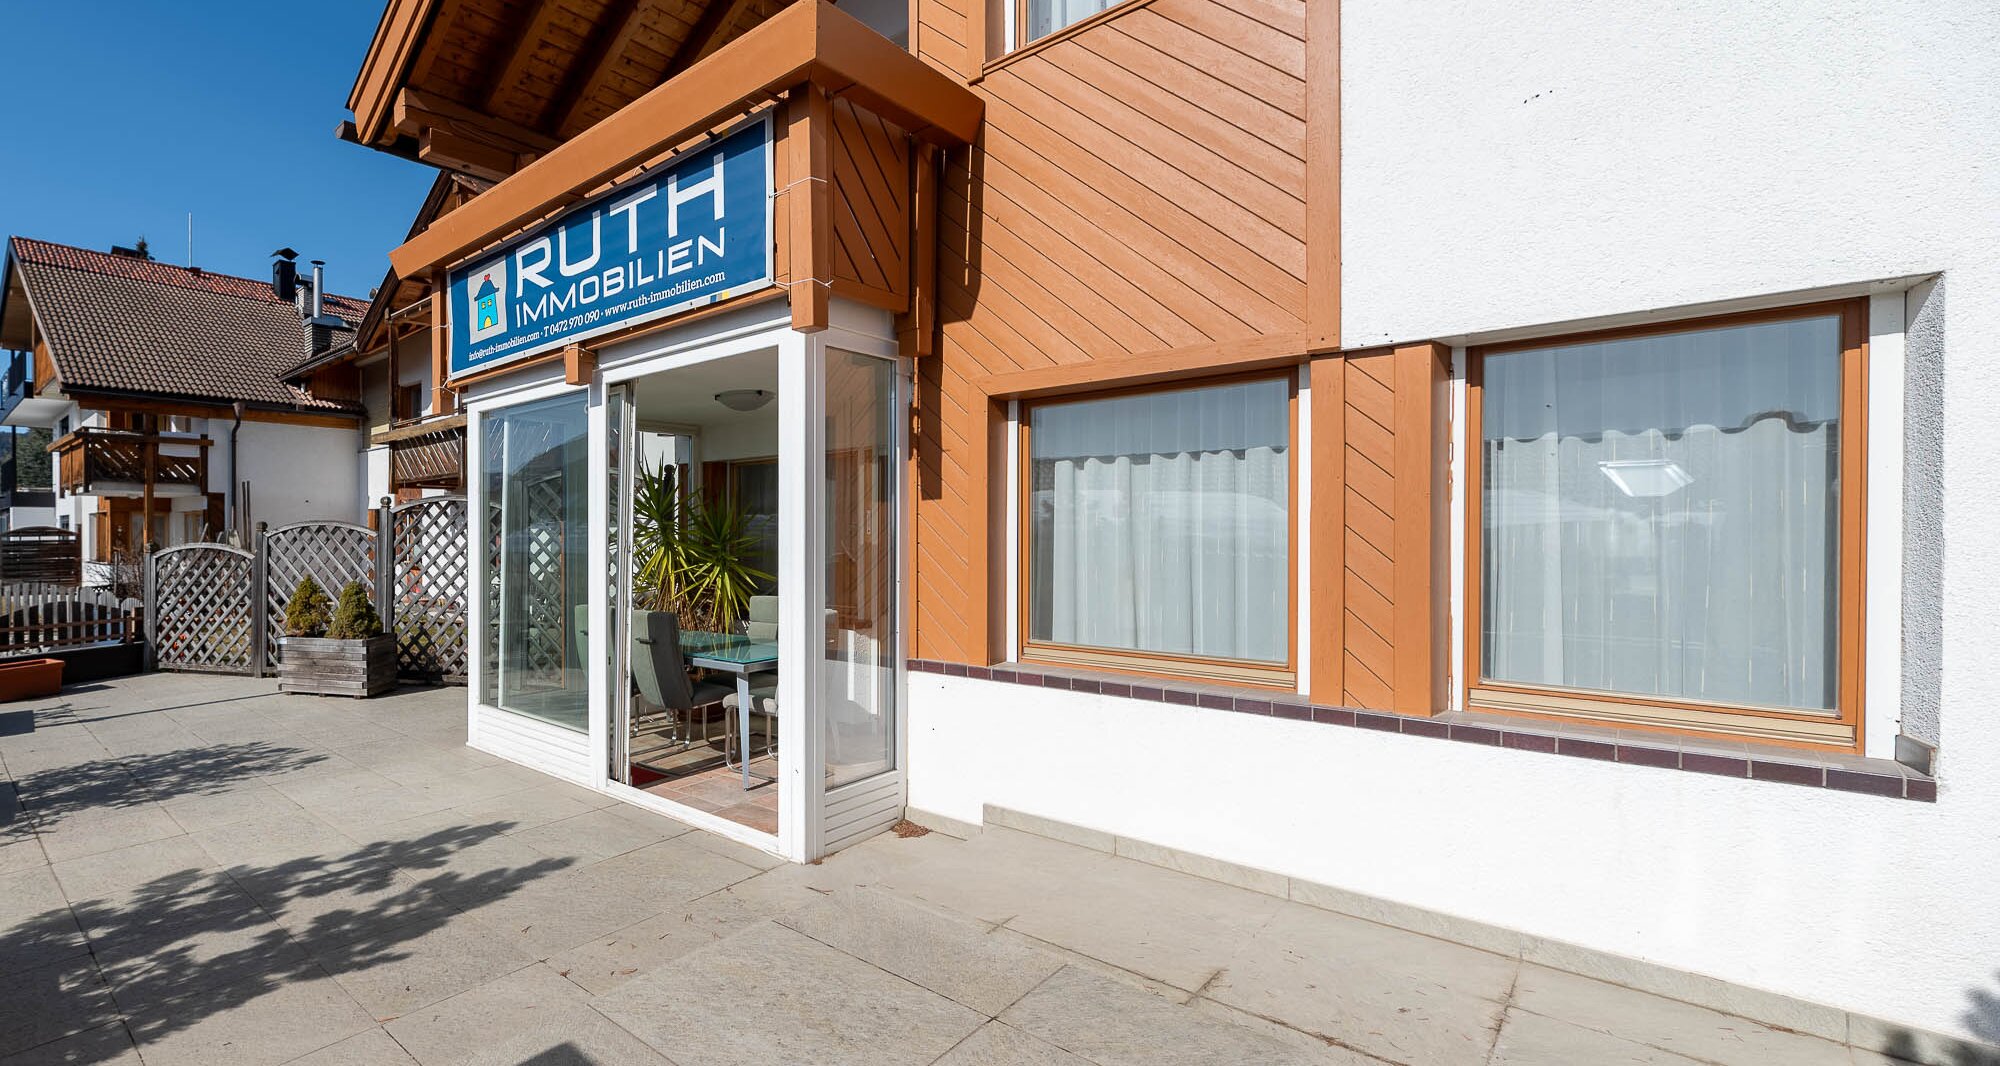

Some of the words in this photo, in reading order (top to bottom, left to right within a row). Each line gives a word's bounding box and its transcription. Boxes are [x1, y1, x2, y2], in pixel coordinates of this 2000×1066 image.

[515, 152, 725, 298] RUTH
[469, 331, 540, 361] info@ruth-immobilien.com
[543, 325, 549, 337] T
[550, 319, 568, 335] 0472
[569, 315, 583, 328] 970
[585, 311, 600, 324] 090
[605, 271, 725, 317] www.ruth-immobilien.com
[516, 226, 725, 328] IMMOBILIEN
